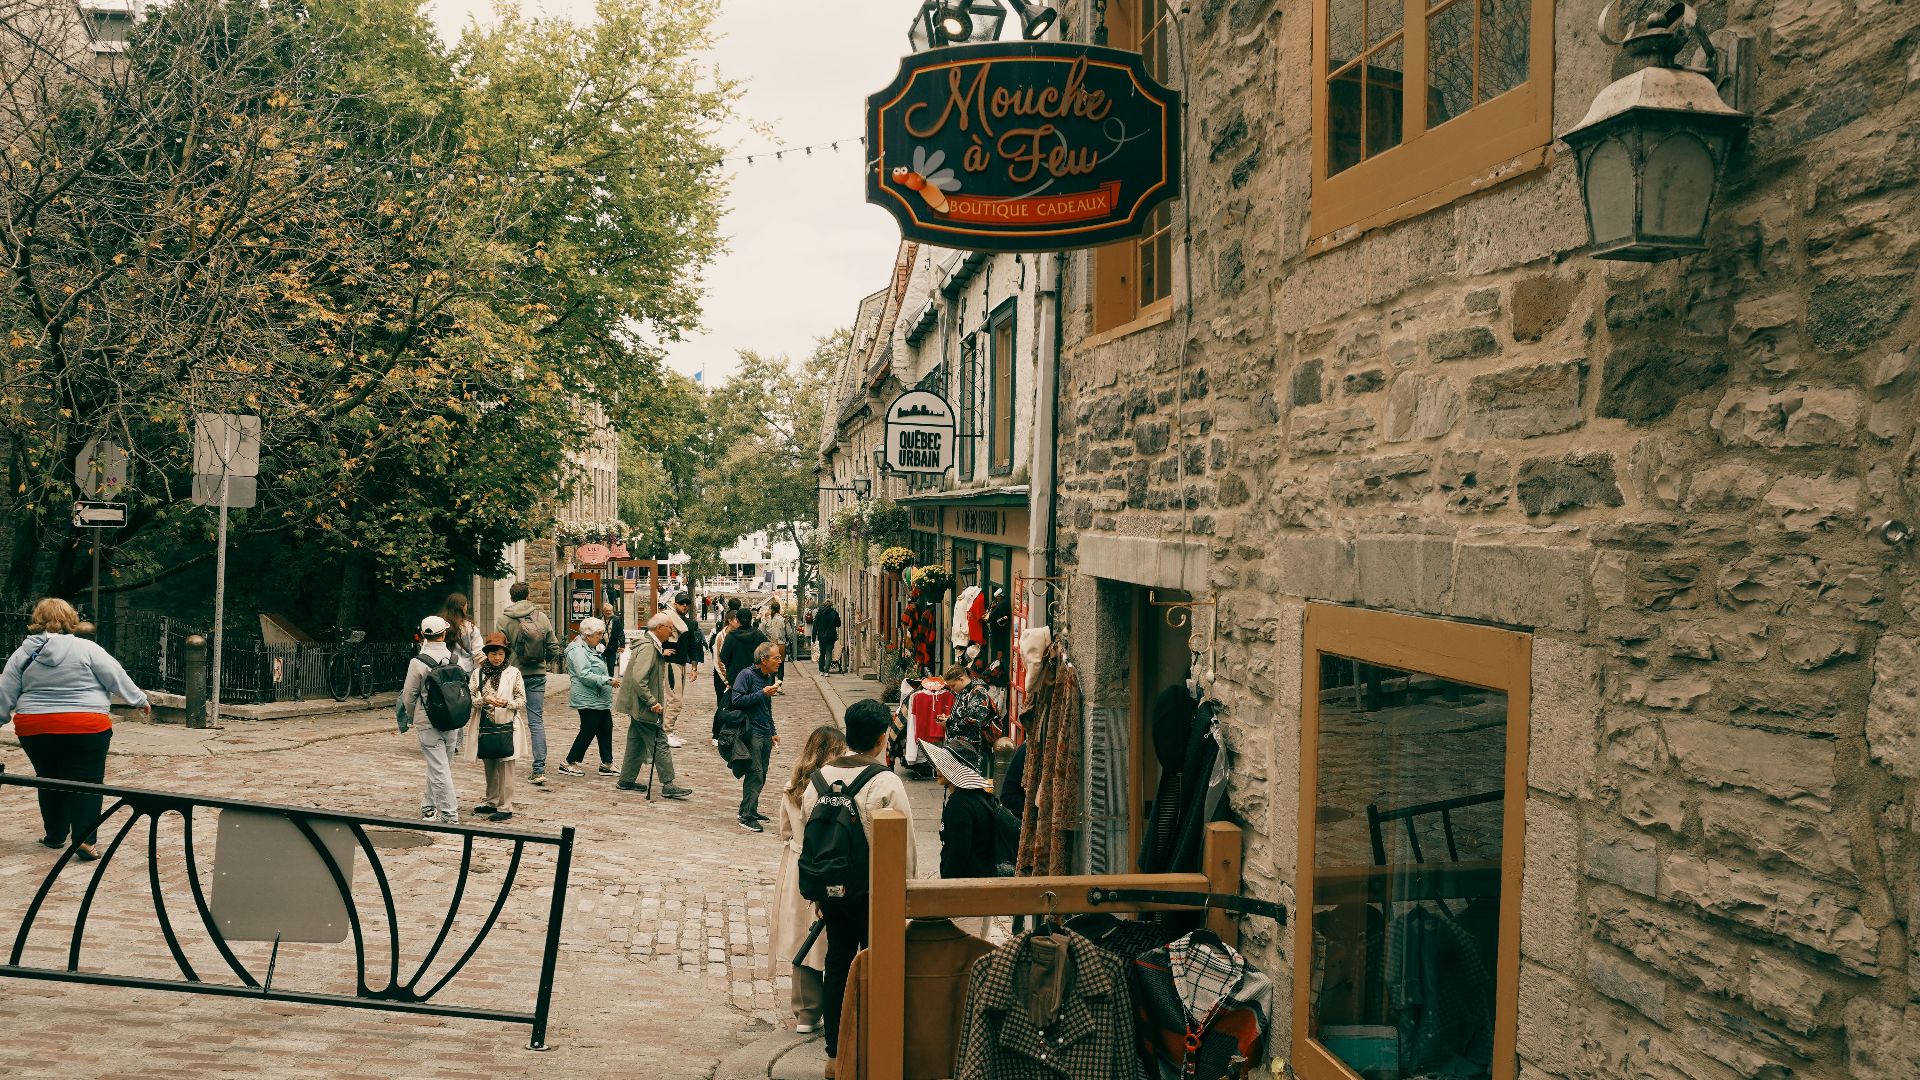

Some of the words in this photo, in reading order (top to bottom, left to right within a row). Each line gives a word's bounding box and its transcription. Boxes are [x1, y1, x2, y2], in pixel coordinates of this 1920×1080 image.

[904, 55, 1113, 138] Mouche
[963, 133, 990, 172] à
[997, 123, 1099, 182] Feu
[950, 200, 1029, 219] BOUTIQUE
[1037, 196, 1107, 216] CADEAUX
[899, 429, 942, 450] QUÉBEC
[898, 449, 940, 468] URBAIN
